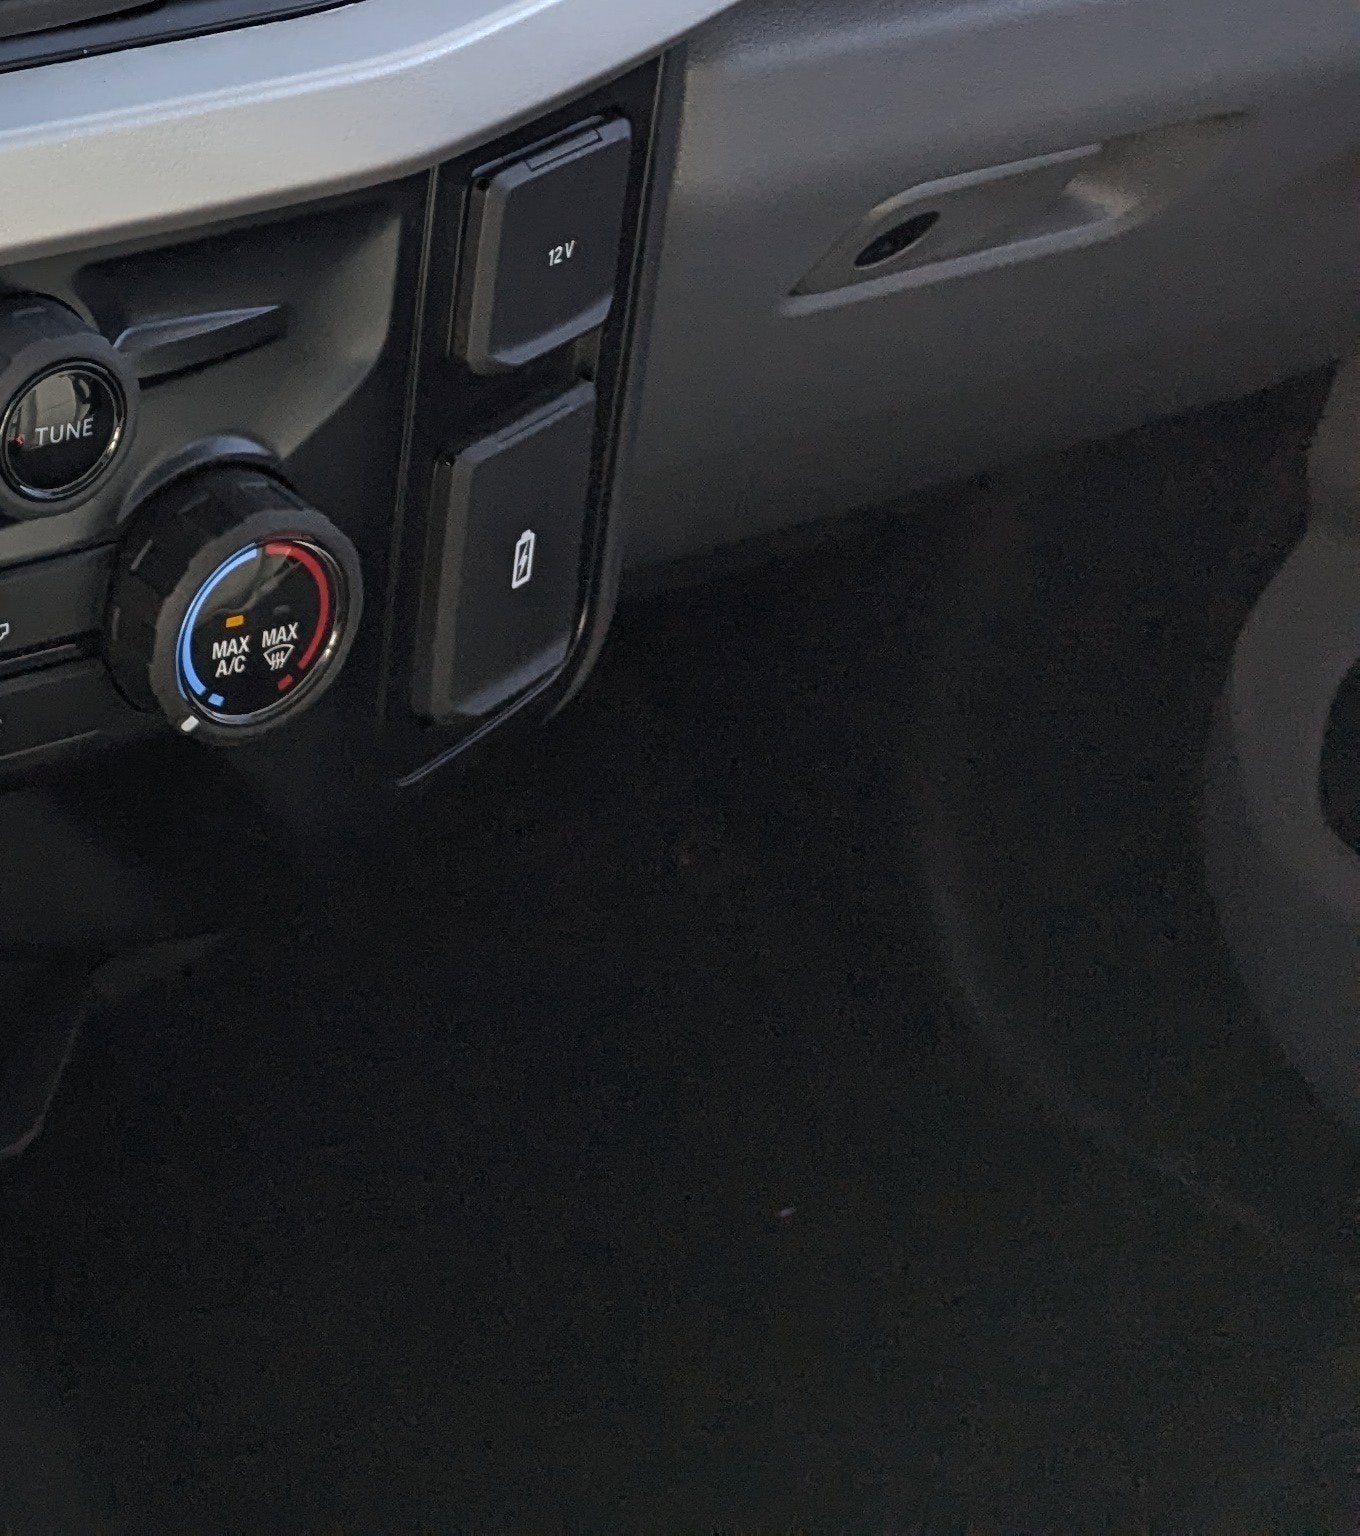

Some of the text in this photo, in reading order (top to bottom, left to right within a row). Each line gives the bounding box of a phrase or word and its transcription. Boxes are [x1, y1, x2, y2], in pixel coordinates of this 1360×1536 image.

[548, 239, 576, 267] 12 V
[35, 417, 94, 447] TUNE
[211, 634, 250, 660] MAX
[261, 621, 299, 648] MAX
[214, 655, 247, 678] A/C
